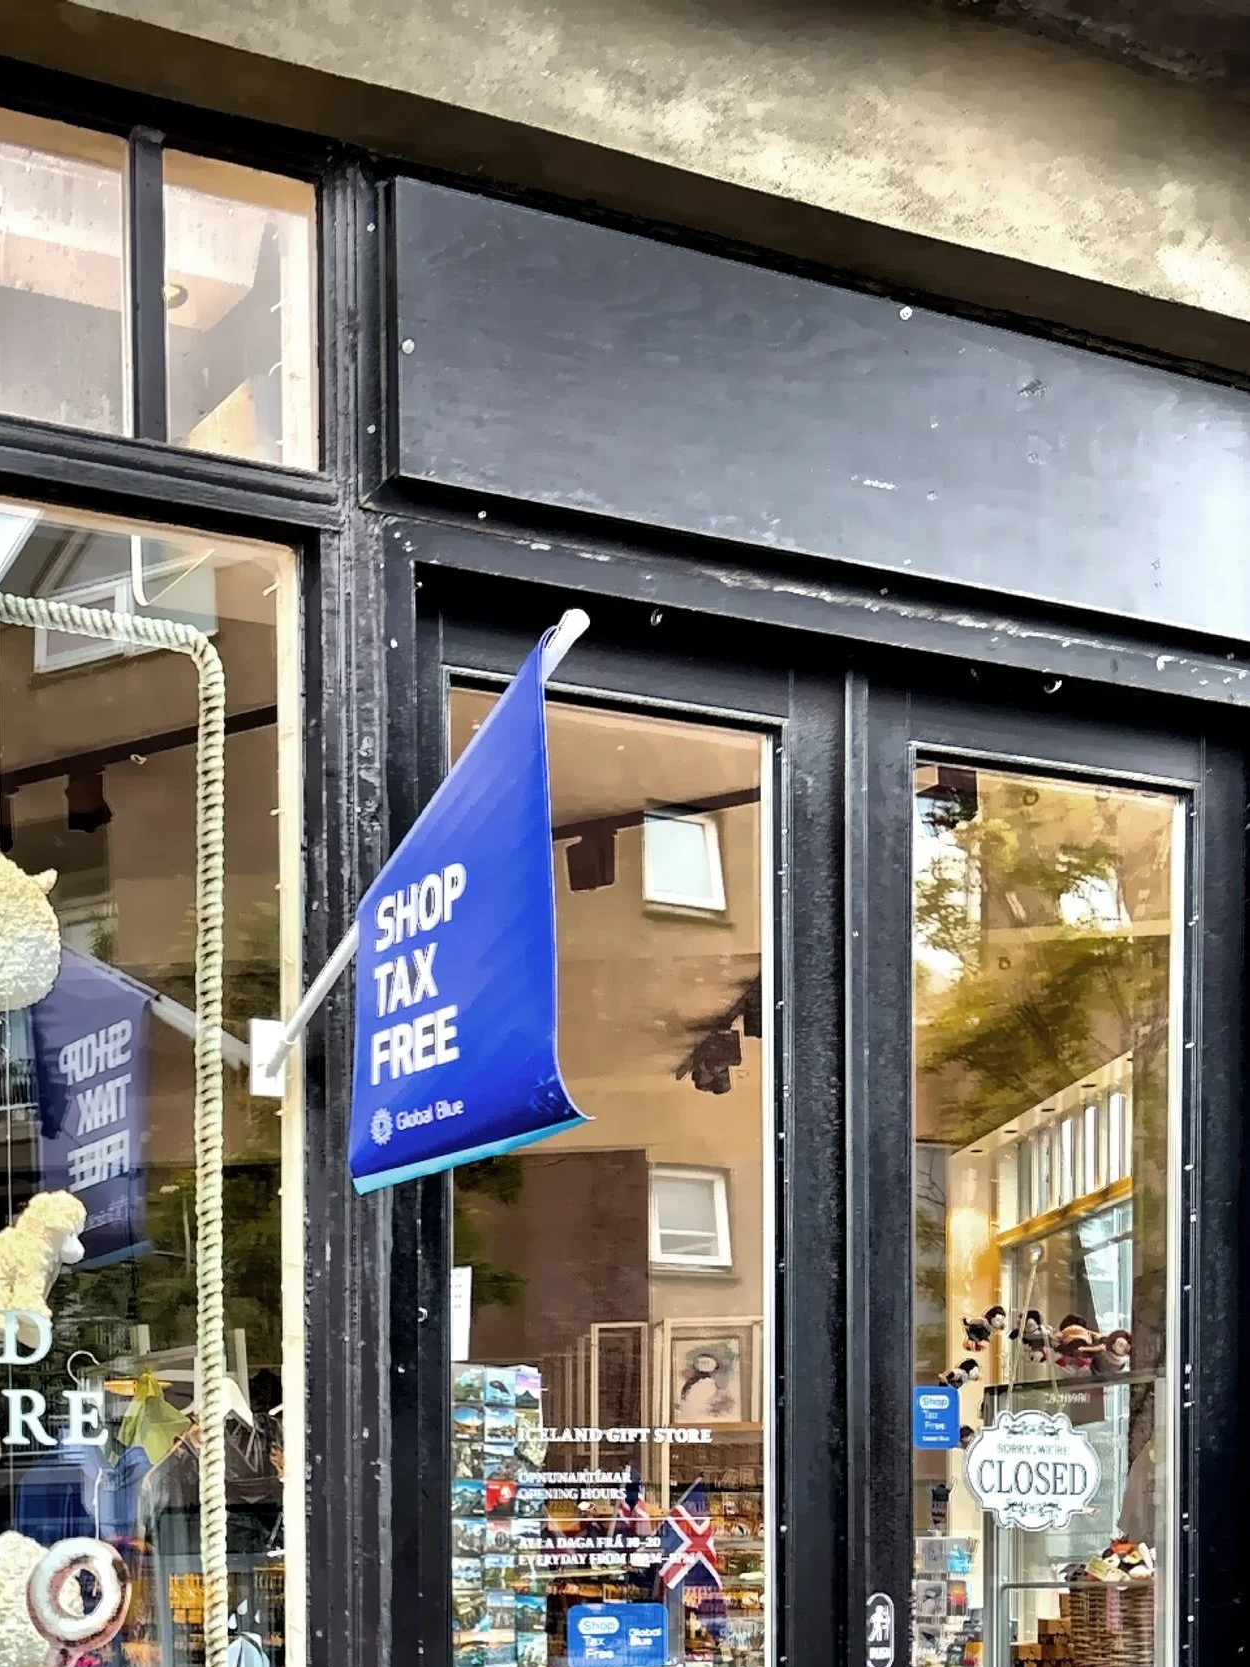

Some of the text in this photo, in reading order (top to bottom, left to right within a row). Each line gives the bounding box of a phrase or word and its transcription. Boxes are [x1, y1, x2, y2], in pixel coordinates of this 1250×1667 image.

[375, 863, 467, 953] SHOP
[373, 942, 439, 1018] TAX
[370, 1004, 460, 1087] FREE
[395, 1099, 465, 1131] Global Blue
[518, 1427, 713, 1444] ICELAND GIFT STORE
[977, 1459, 1087, 1496] CLOSED
[518, 1487, 627, 1500] OPENING HOURS
[518, 1553, 587, 1566] EVERYDAY
[589, 1553, 627, 1565] FROM
[583, 1620, 616, 1632] Shop
[582, 1635, 606, 1647] Tax
[585, 1648, 615, 1659] Free
